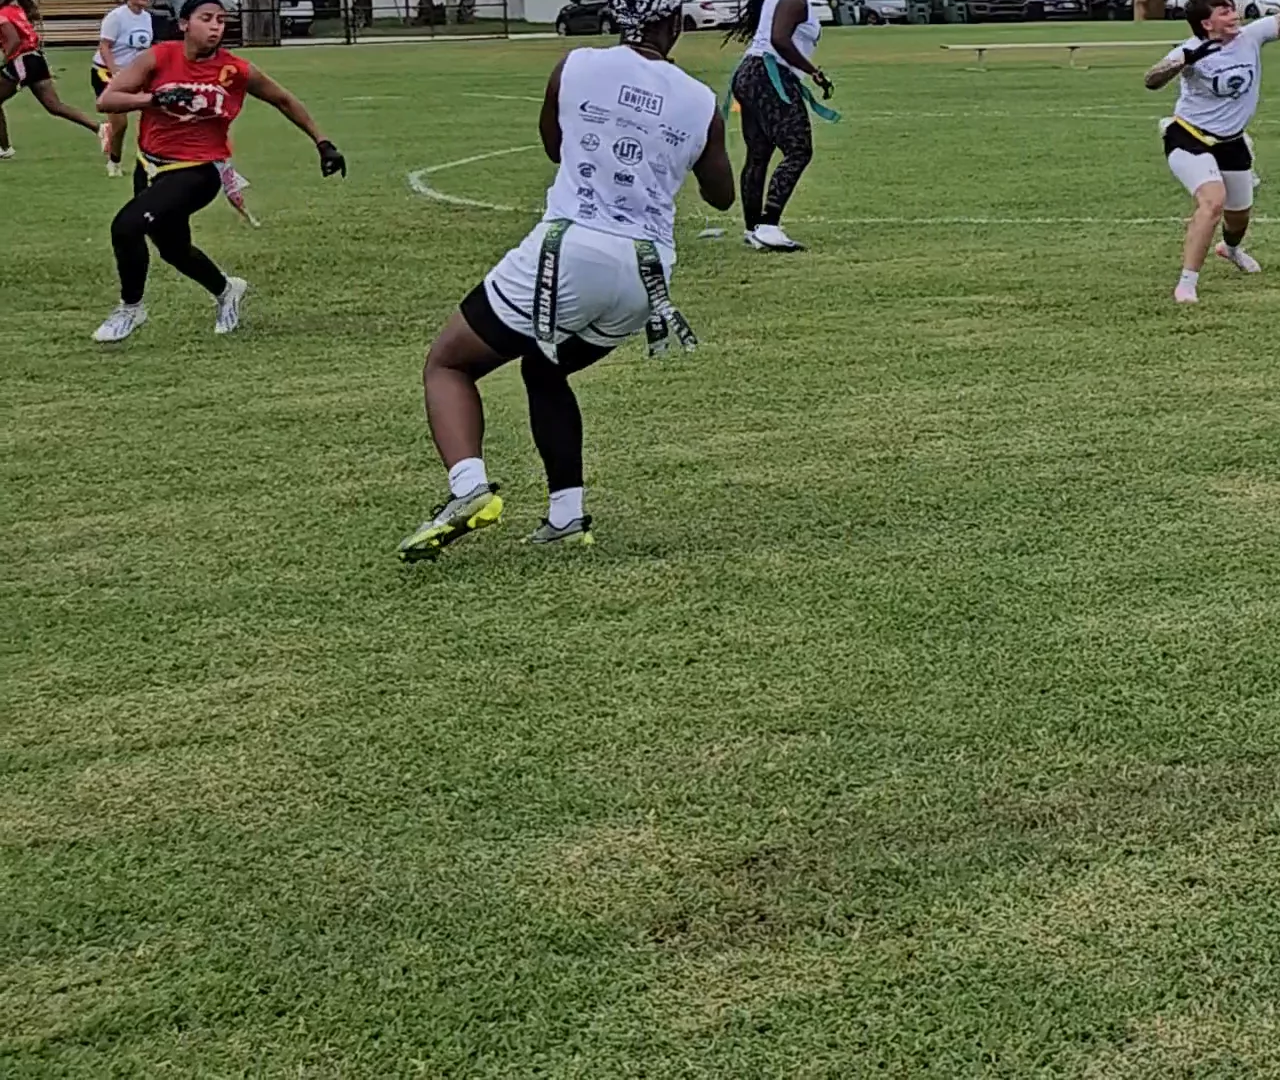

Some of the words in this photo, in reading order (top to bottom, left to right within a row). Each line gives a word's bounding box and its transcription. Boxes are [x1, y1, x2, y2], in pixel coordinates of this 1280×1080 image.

[624, 90, 658, 111] UNITES
[542, 251, 555, 287] FORT
[538, 287, 553, 333] MYERS
